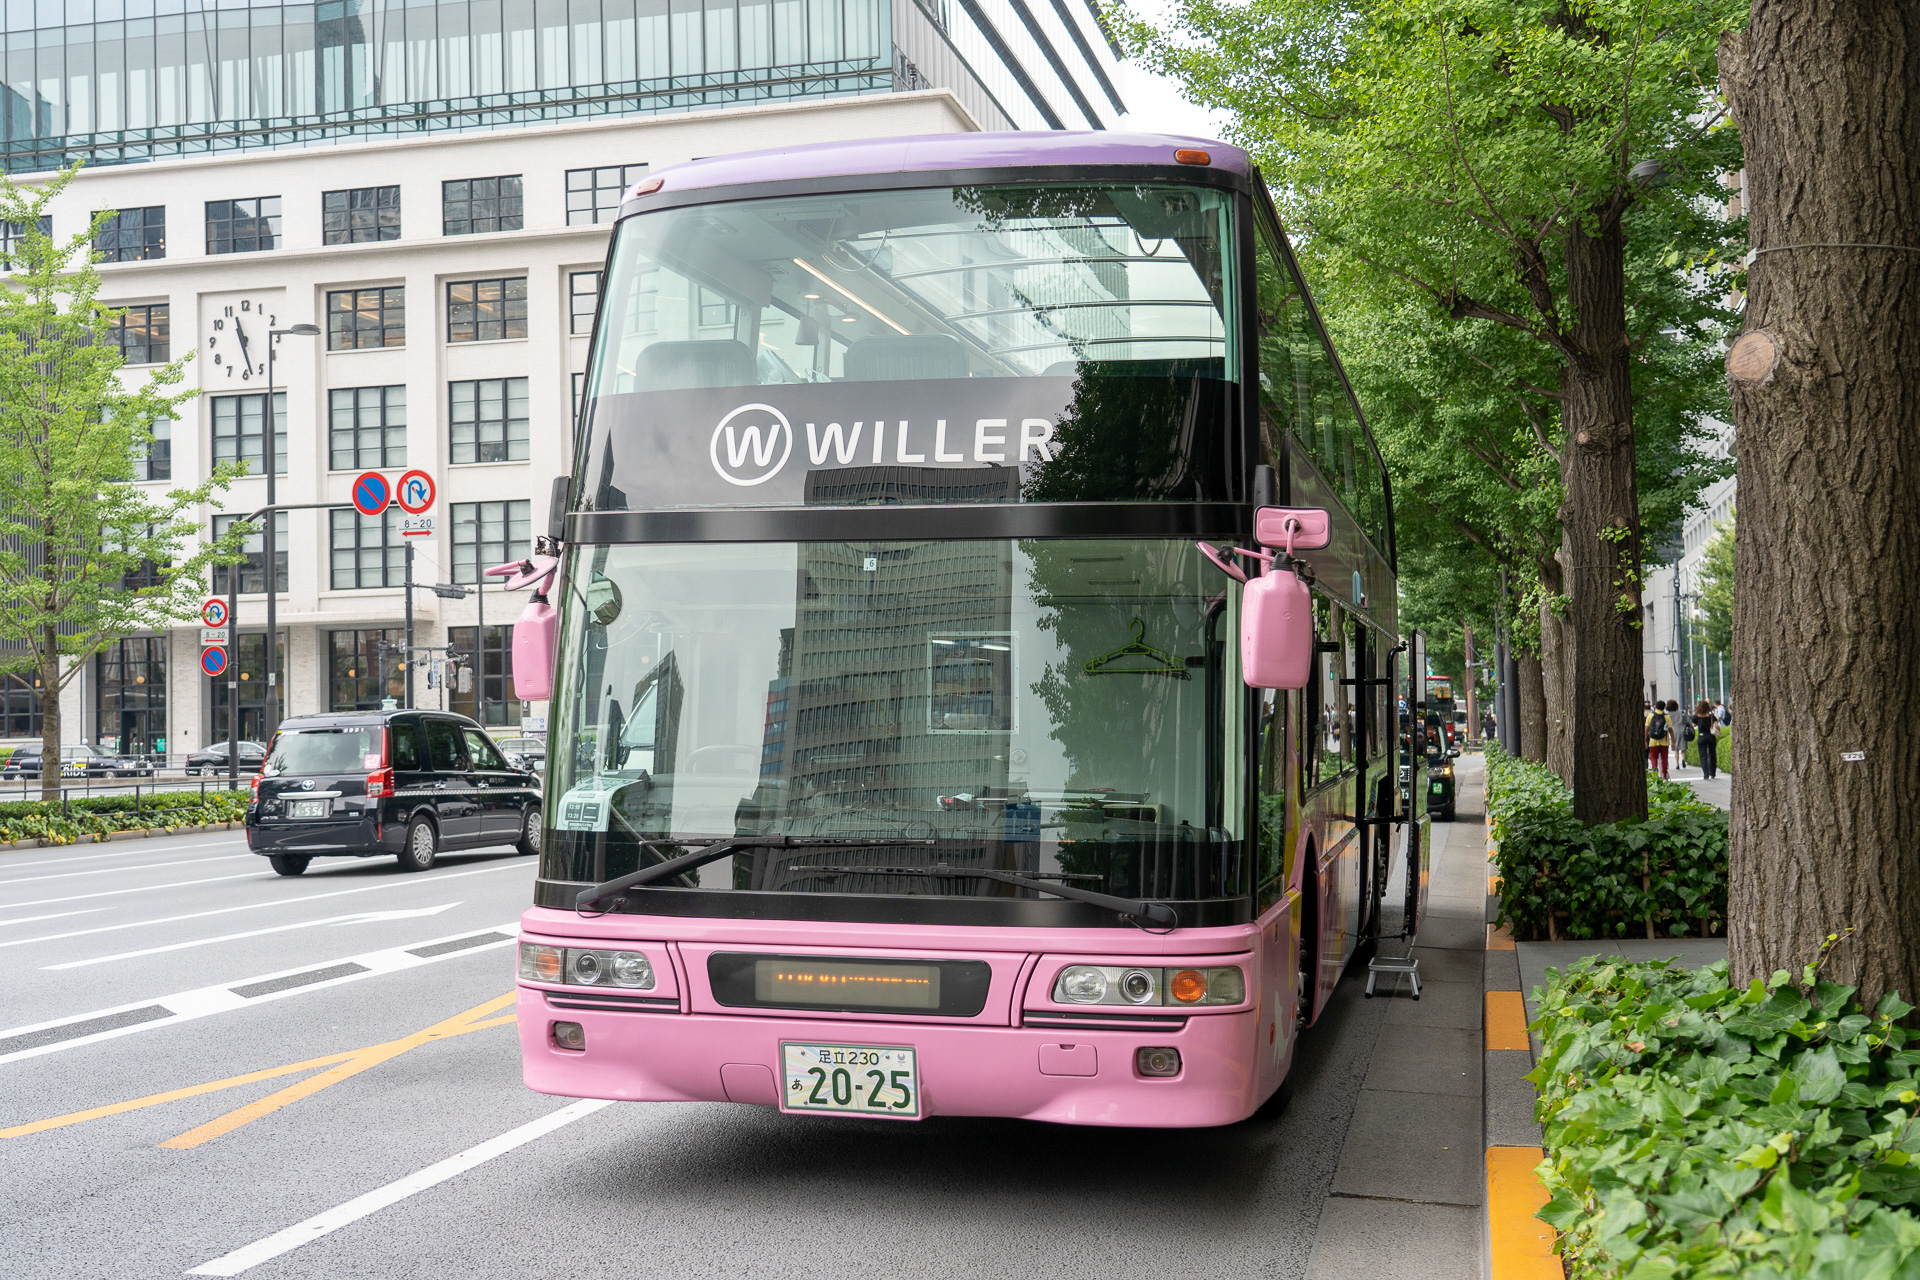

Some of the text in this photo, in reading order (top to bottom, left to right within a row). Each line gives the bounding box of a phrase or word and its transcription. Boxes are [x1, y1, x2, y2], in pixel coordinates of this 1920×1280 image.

[241, 300, 250, 311] 12
[225, 306, 232, 317] 11
[214, 320, 223, 331] 10
[270, 315, 275, 326] 2
[210, 337, 216, 348] 9
[215, 354, 221, 365] 8
[227, 366, 232, 377] 7
[243, 370, 249, 380] 6
[259, 364, 264, 375] 5
[806, 418, 1054, 466] WILLER
[819, 1050, 880, 1066] 足立230
[791, 1066, 911, 1109] あ 20-25
